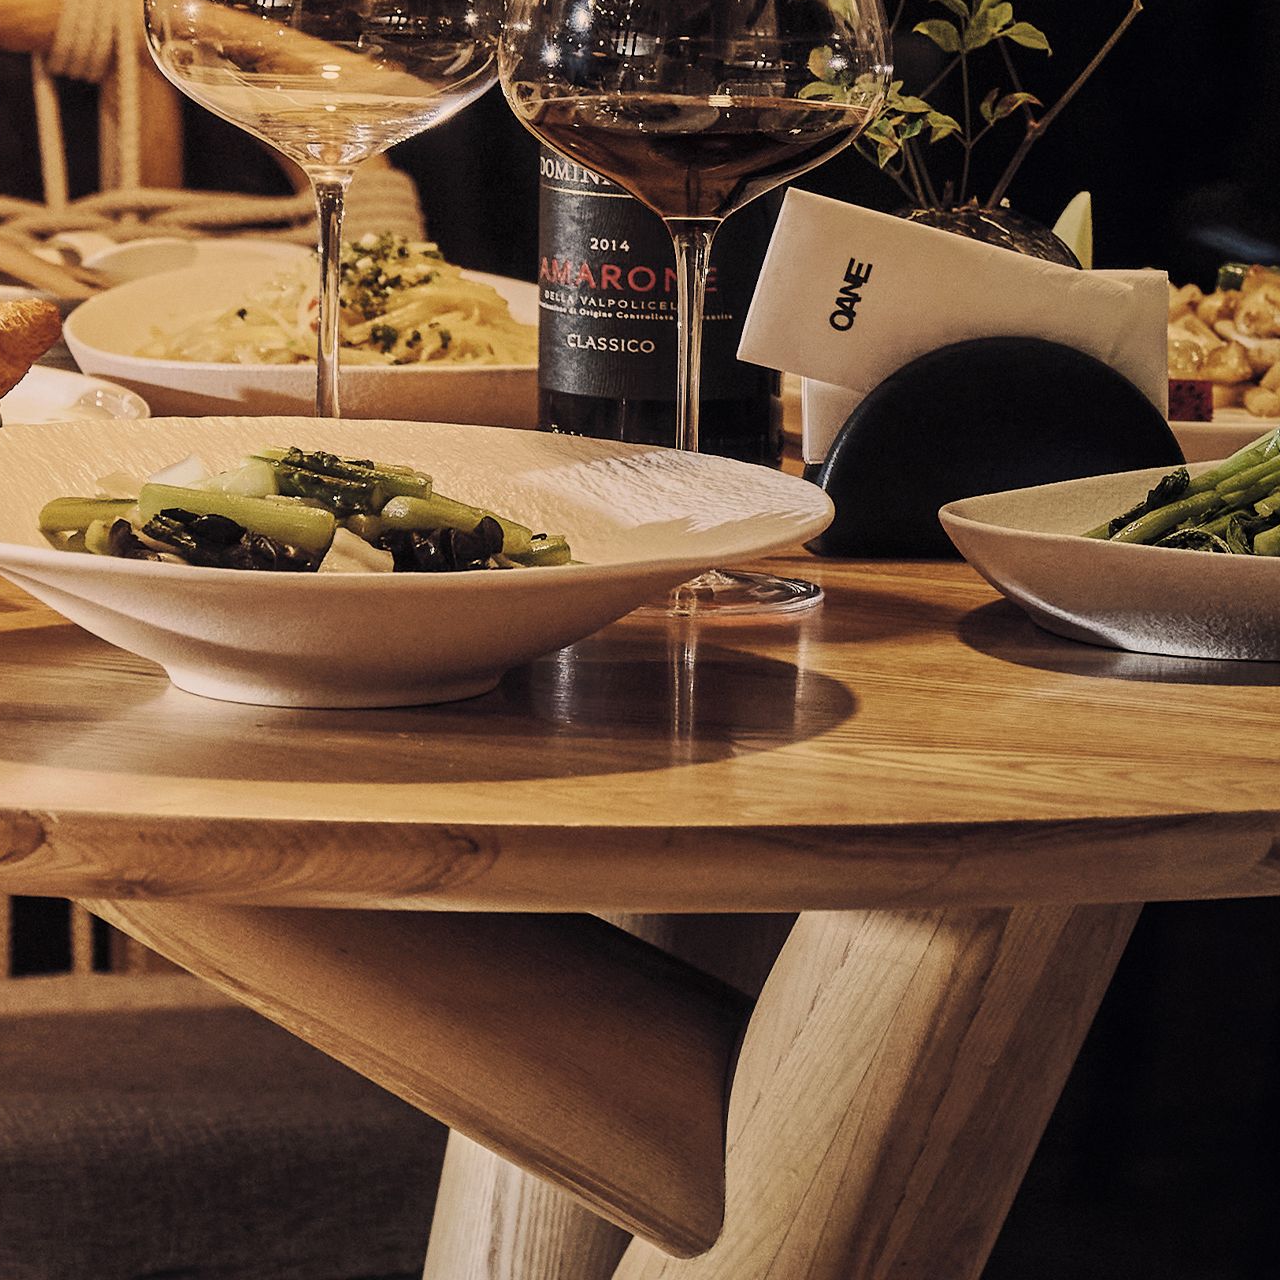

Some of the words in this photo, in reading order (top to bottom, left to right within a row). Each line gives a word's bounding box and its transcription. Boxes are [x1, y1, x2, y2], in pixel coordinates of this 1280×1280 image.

[540, 156, 611, 186] DOMIN
[590, 237, 630, 252] 2014
[544, 289, 576, 306] DELLA
[579, 295, 677, 311] VALPOLICEL
[829, 257, 873, 332] OANE
[567, 332, 655, 354] CLASSICO
